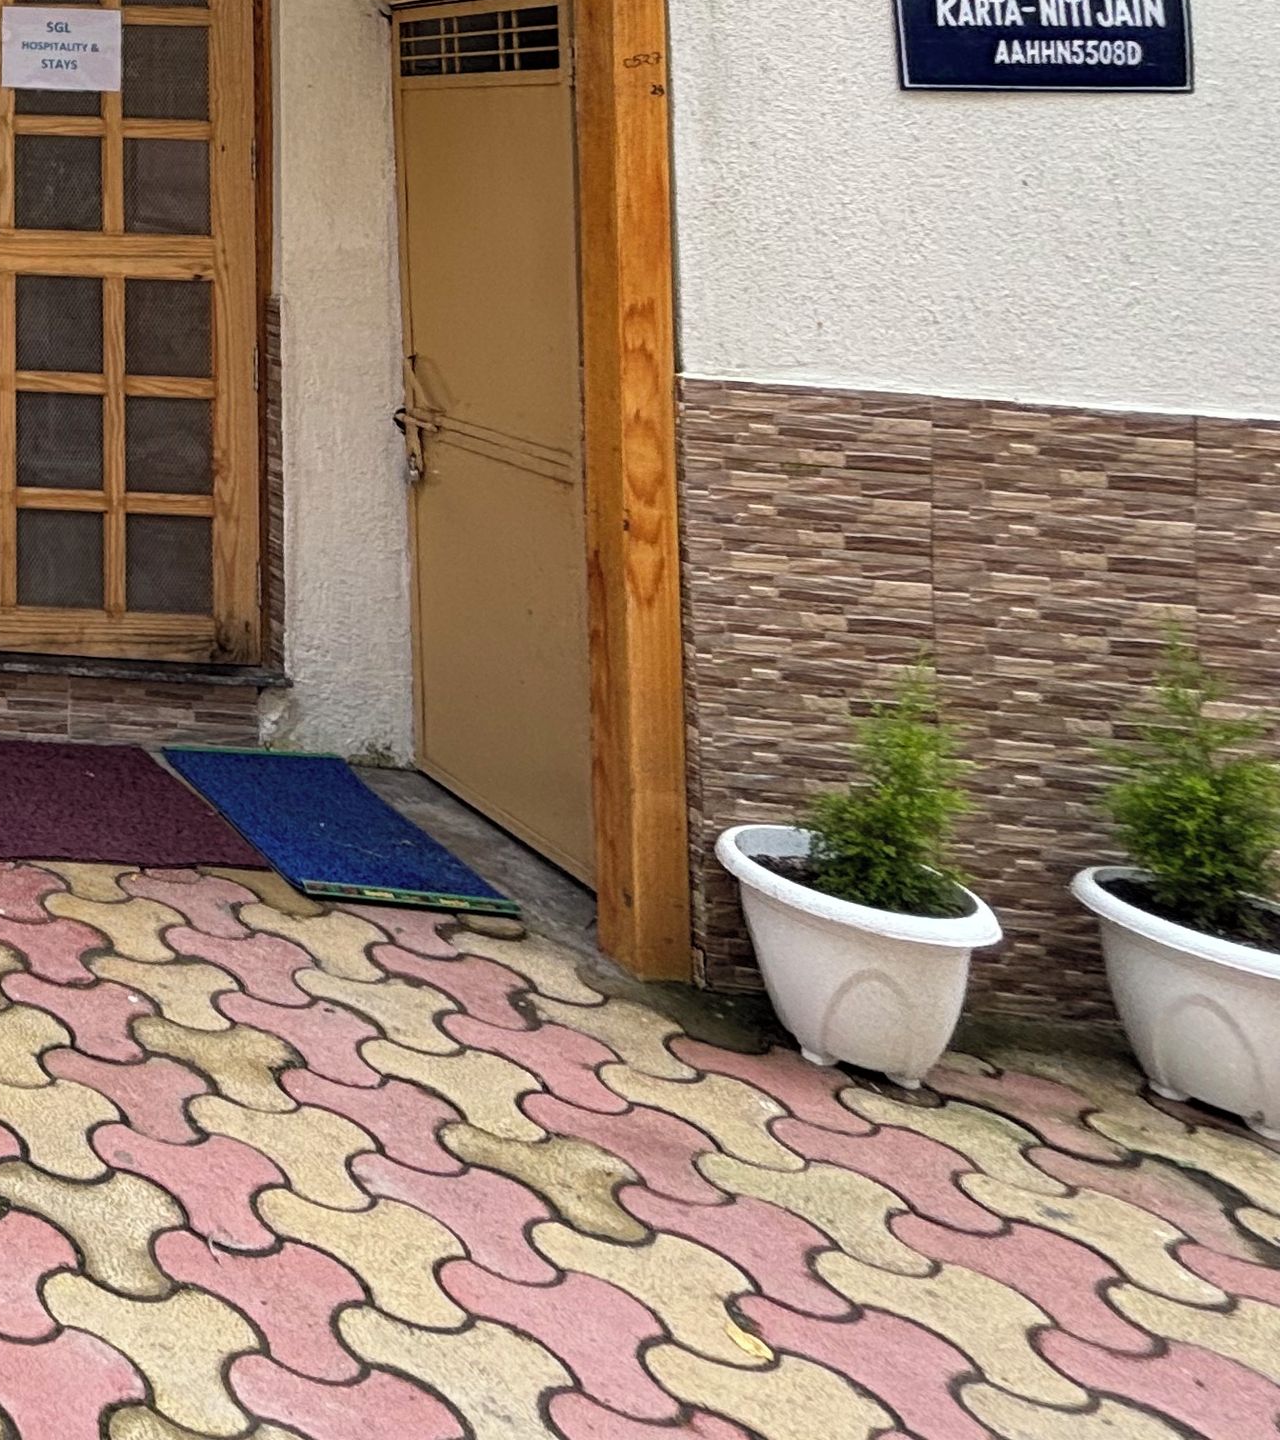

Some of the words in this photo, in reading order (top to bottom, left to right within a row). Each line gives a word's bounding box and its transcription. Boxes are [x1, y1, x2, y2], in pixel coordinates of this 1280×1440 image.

[45, 20, 72, 34] SGL
[21, 40, 88, 53] HOSPITALITY
[90, 43, 100, 53] &
[994, 39, 1143, 66] AAHHN5508D
[40, 58, 78, 71] STAYS
